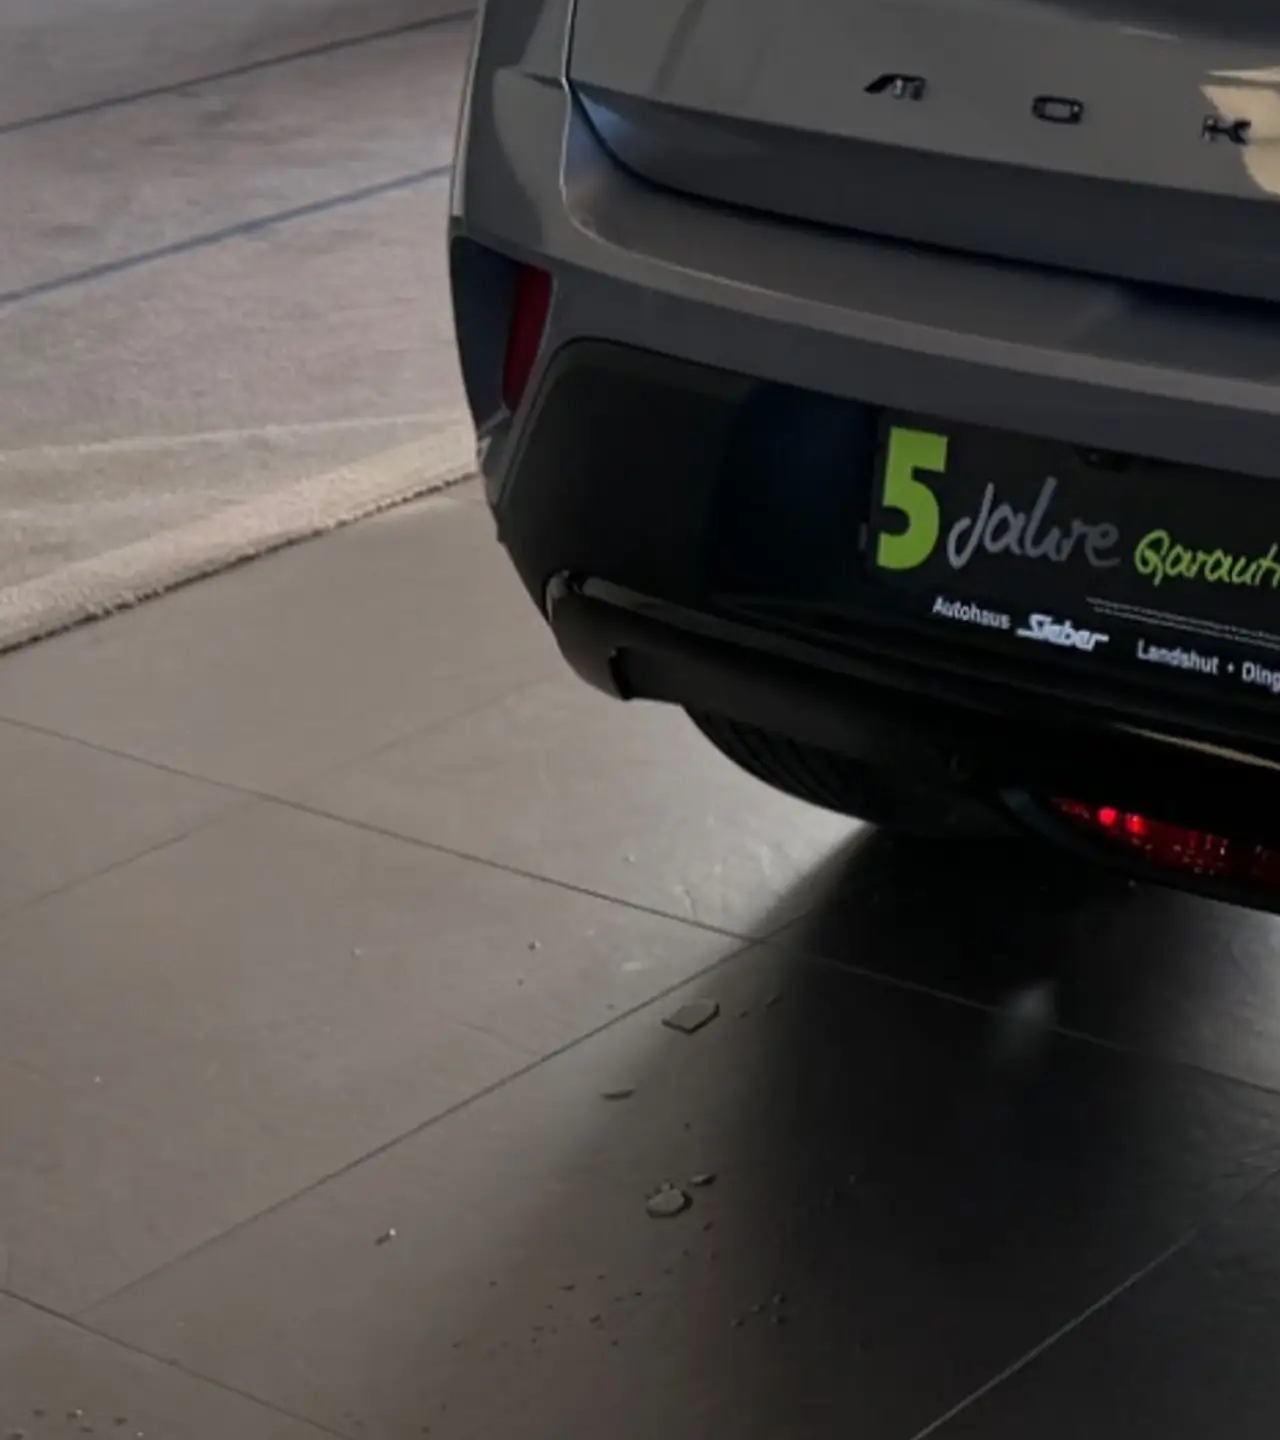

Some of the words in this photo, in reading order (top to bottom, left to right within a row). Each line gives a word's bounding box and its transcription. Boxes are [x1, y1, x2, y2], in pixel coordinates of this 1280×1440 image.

[876, 426, 949, 570] 5
[946, 475, 1122, 570] Jahre
[932, 595, 1011, 631] Autohaus
[1015, 612, 1110, 653] Sieber
[1136, 639, 1219, 677] Landshut
